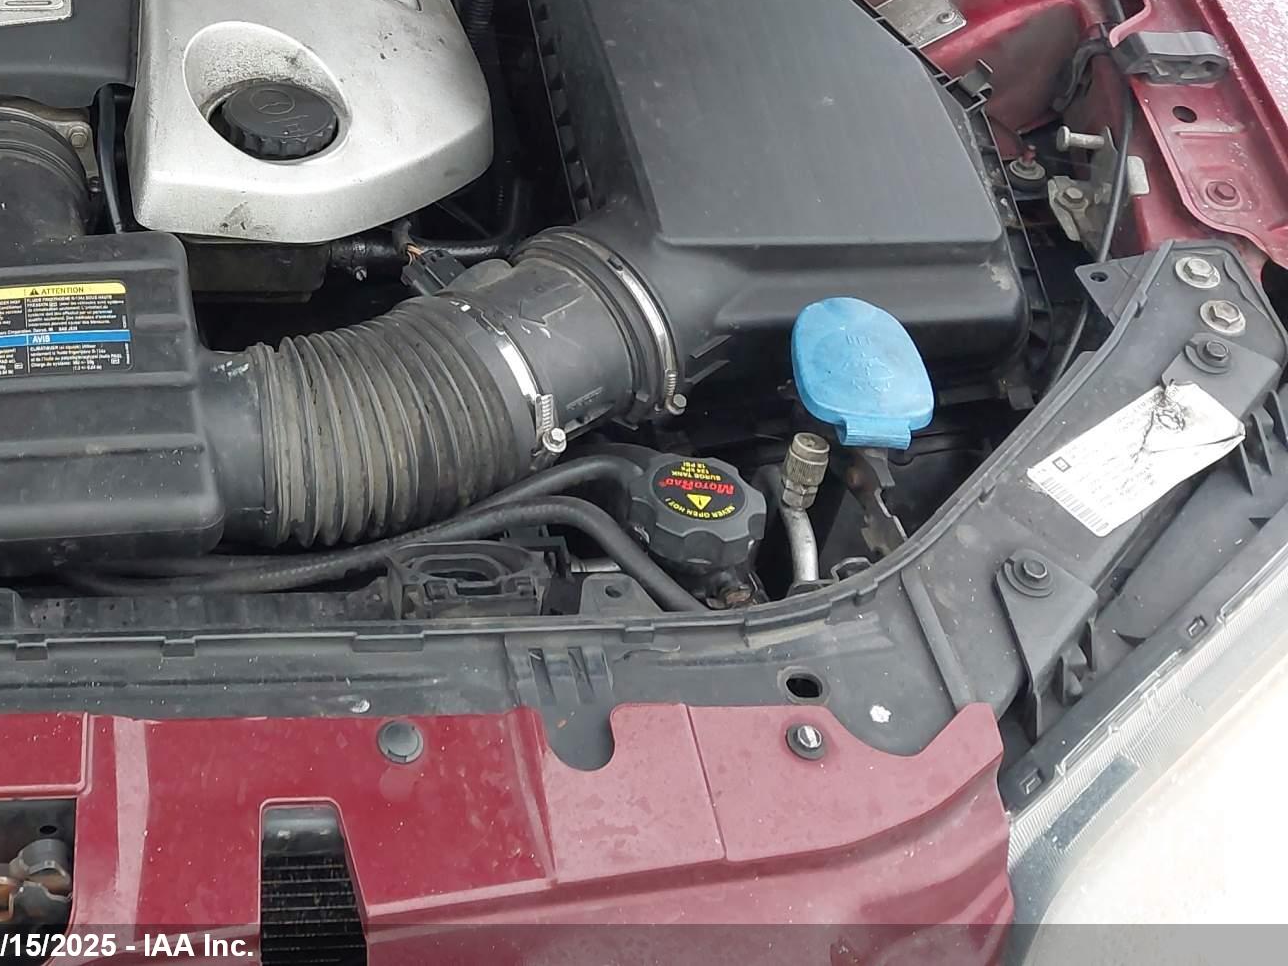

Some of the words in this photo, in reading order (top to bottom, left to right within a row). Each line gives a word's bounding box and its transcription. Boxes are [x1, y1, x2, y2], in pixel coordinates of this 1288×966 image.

[42, 286, 84, 295] ATTENTION
[32, 335, 50, 343] AVIS
[686, 510, 710, 518] OPEN
